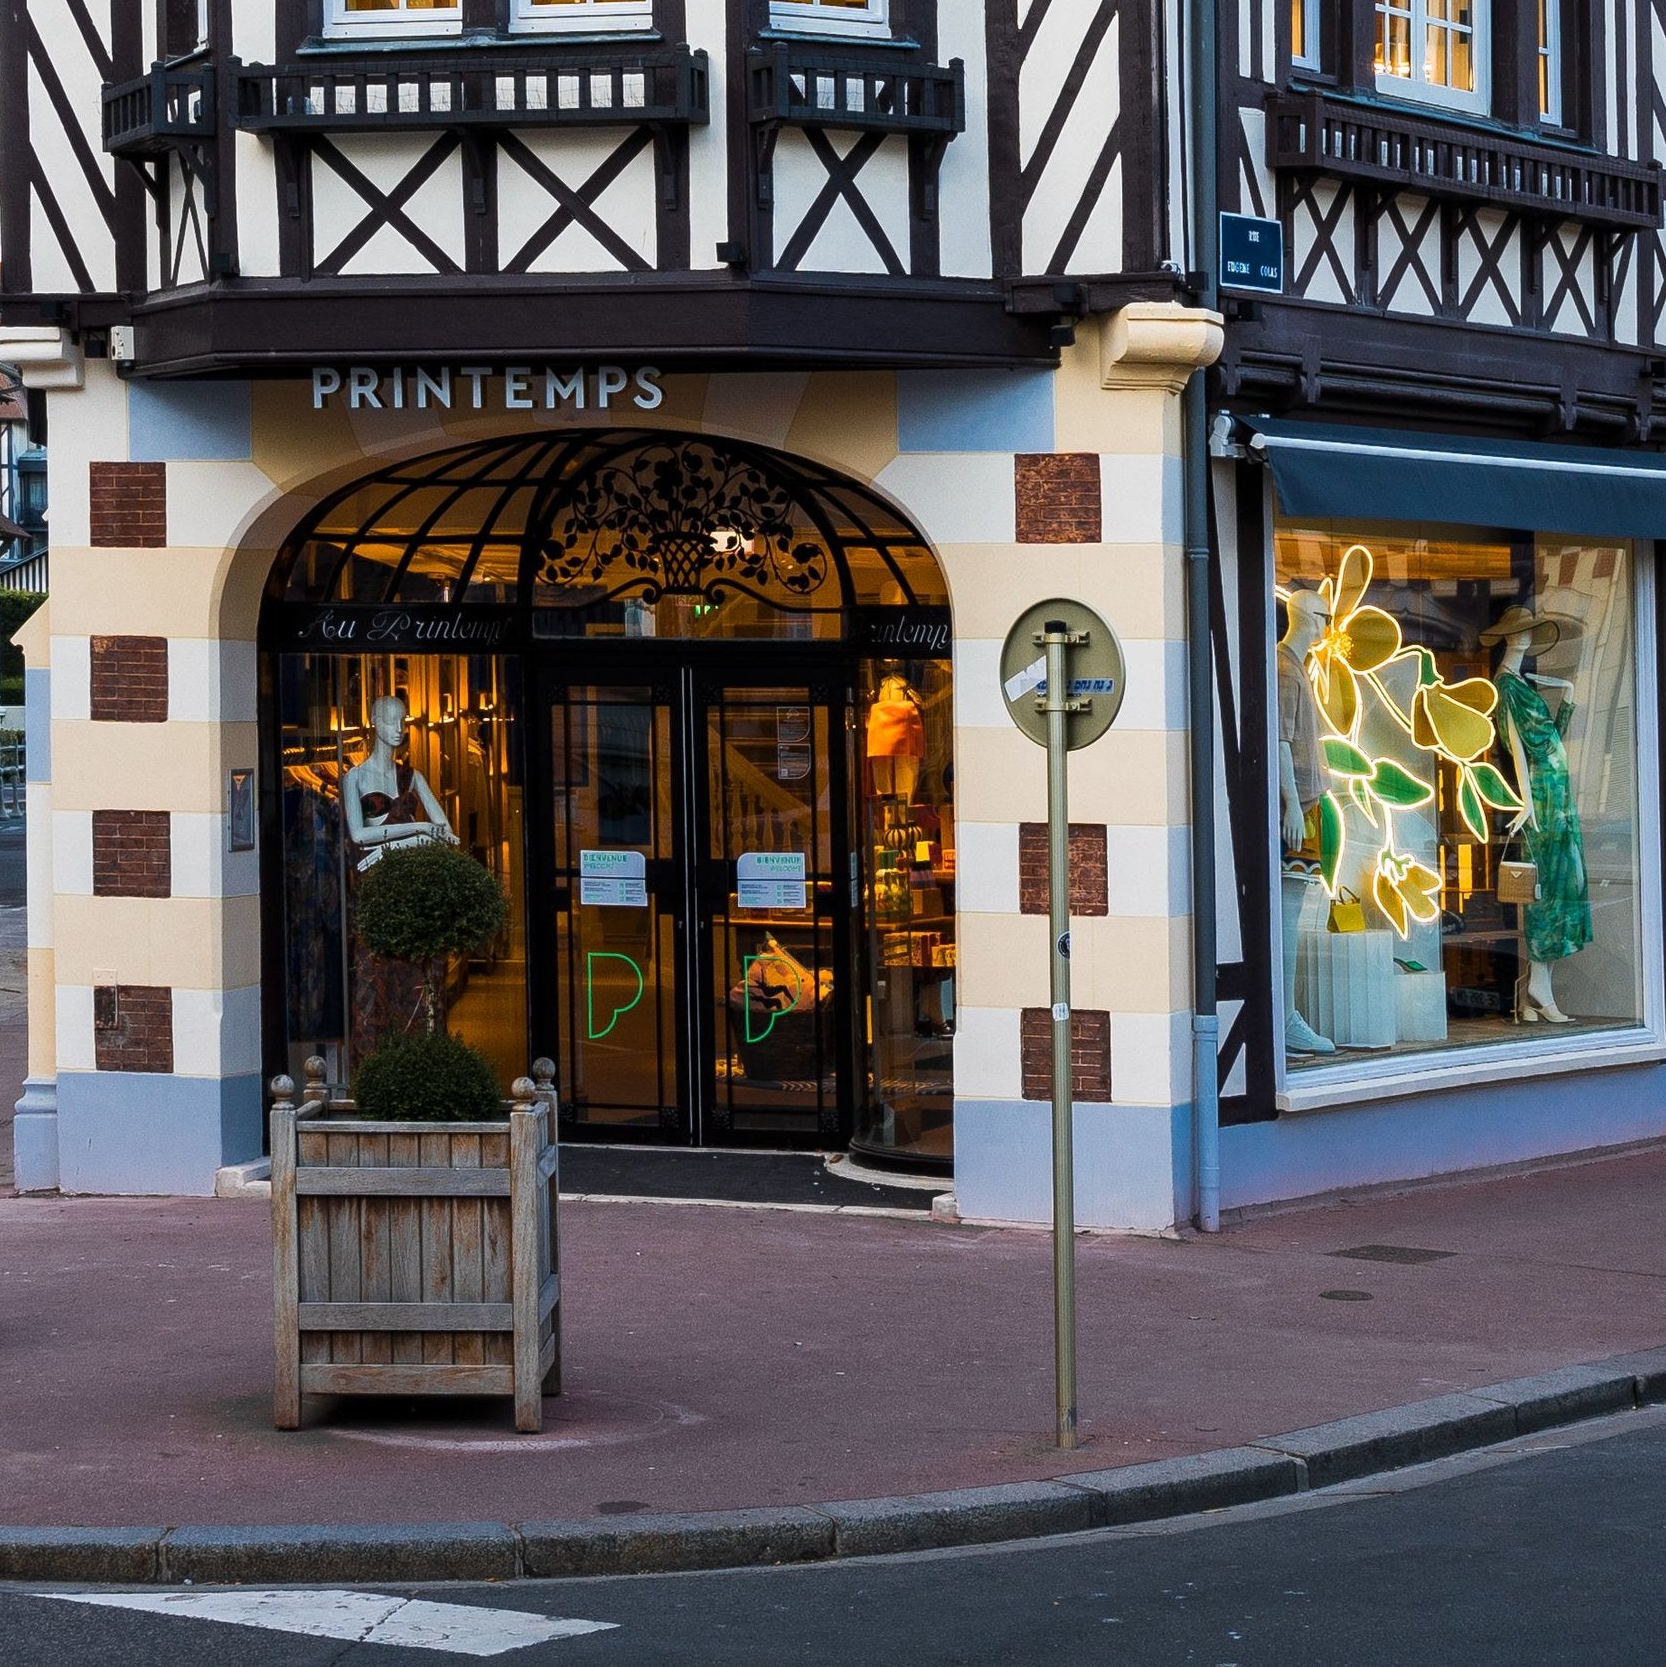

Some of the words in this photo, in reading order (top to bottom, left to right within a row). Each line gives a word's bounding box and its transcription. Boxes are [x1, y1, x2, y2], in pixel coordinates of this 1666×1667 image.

[1248, 230, 1260, 243] RUE
[1260, 265, 1278, 278] COLAS
[313, 366, 663, 409] PRINTEMPS
[298, 609, 356, 640] Au
[583, 853, 628, 863] BIENVENUE
